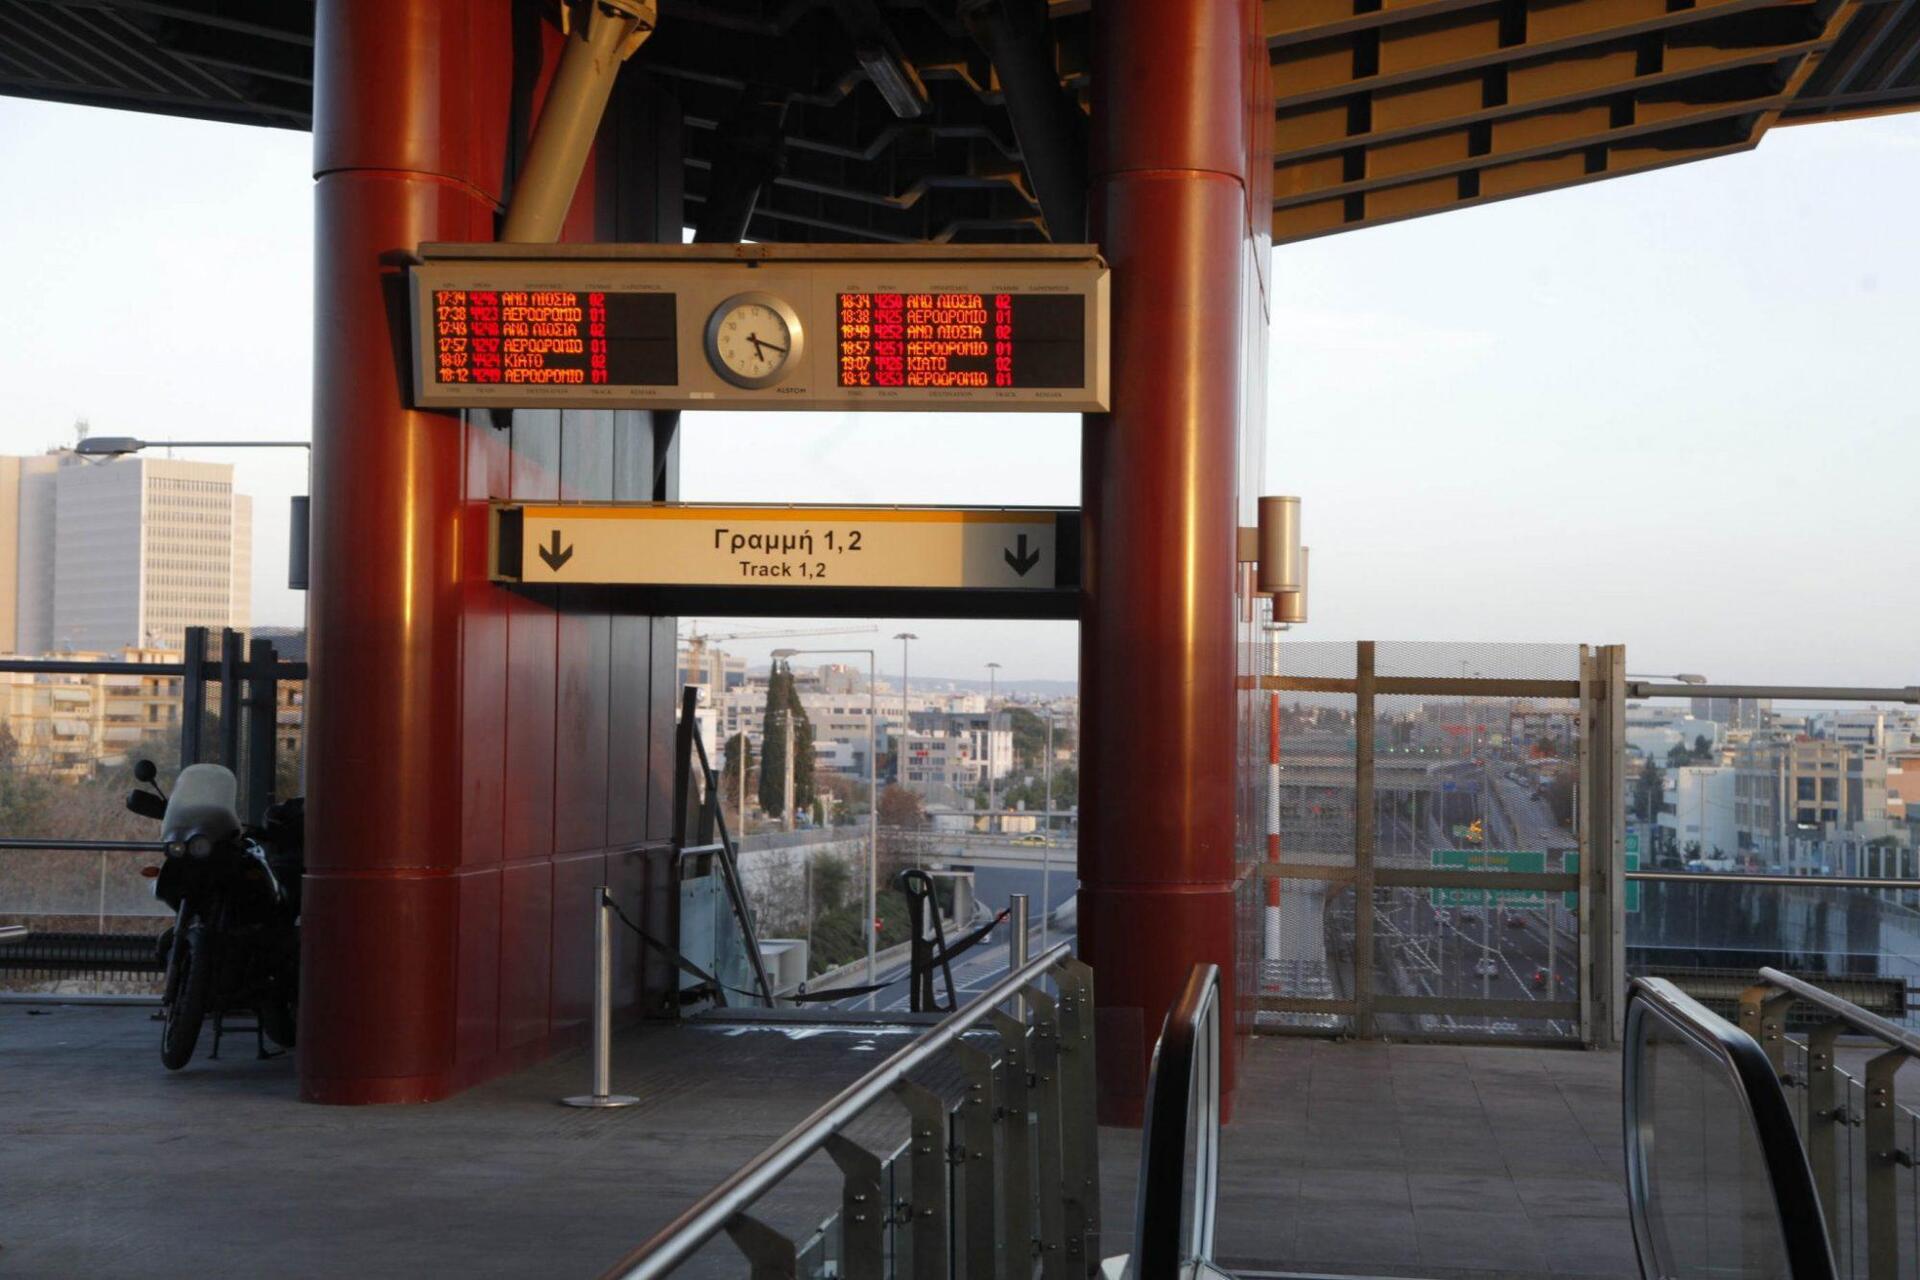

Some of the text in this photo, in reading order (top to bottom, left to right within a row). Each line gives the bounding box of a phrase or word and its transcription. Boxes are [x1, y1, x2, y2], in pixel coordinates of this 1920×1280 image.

[436, 292, 466, 305] 17:34
[589, 292, 604, 306] 02
[841, 294, 871, 308] 18:34
[995, 294, 1012, 308] 02
[437, 306, 467, 320] 17:38
[590, 307, 606, 322] 01
[841, 310, 871, 323] 18:38
[995, 310, 1012, 324] 01
[438, 322, 467, 336] 17:49
[590, 323, 605, 337] 02
[841, 324, 871, 338] 18:49
[995, 324, 1012, 339] 02
[439, 338, 468, 352] 17:57
[591, 339, 606, 353] 01
[841, 341, 871, 355] 18:57
[875, 341, 903, 355] 4251
[995, 341, 1012, 355] 01
[440, 354, 468, 367] 18:07
[591, 354, 606, 368] 02
[841, 356, 871, 370] 19:07
[995, 356, 1012, 371] 02
[440, 368, 468, 382] 18:12
[592, 369, 608, 384] 01
[841, 372, 871, 386] 19:12
[995, 372, 1012, 386] 01
[714, 528, 862, 554] Γραμμή 1,2
[739, 561, 826, 580] Track 1,2
